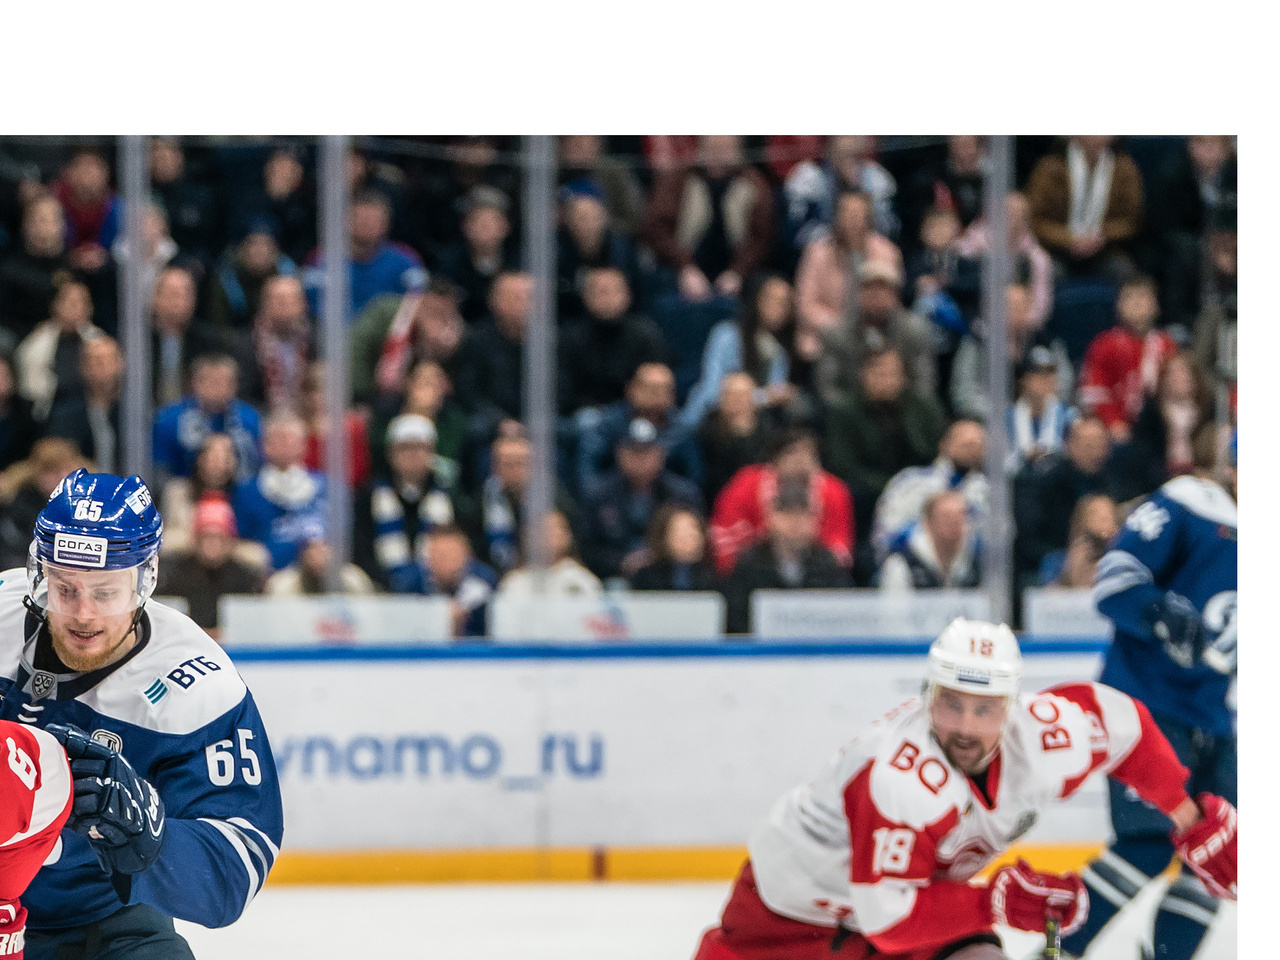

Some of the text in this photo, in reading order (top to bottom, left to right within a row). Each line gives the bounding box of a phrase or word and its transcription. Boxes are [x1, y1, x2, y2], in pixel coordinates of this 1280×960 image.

[74, 499, 104, 522] 65
[58, 539, 103, 552] СОГАЗ
[969, 638, 994, 656] 18
[169, 655, 221, 691] ВТБ
[6, 736, 37, 790] 6
[205, 728, 262, 787] 65
[888, 740, 949, 795] BQ
[872, 826, 918, 875] 18
